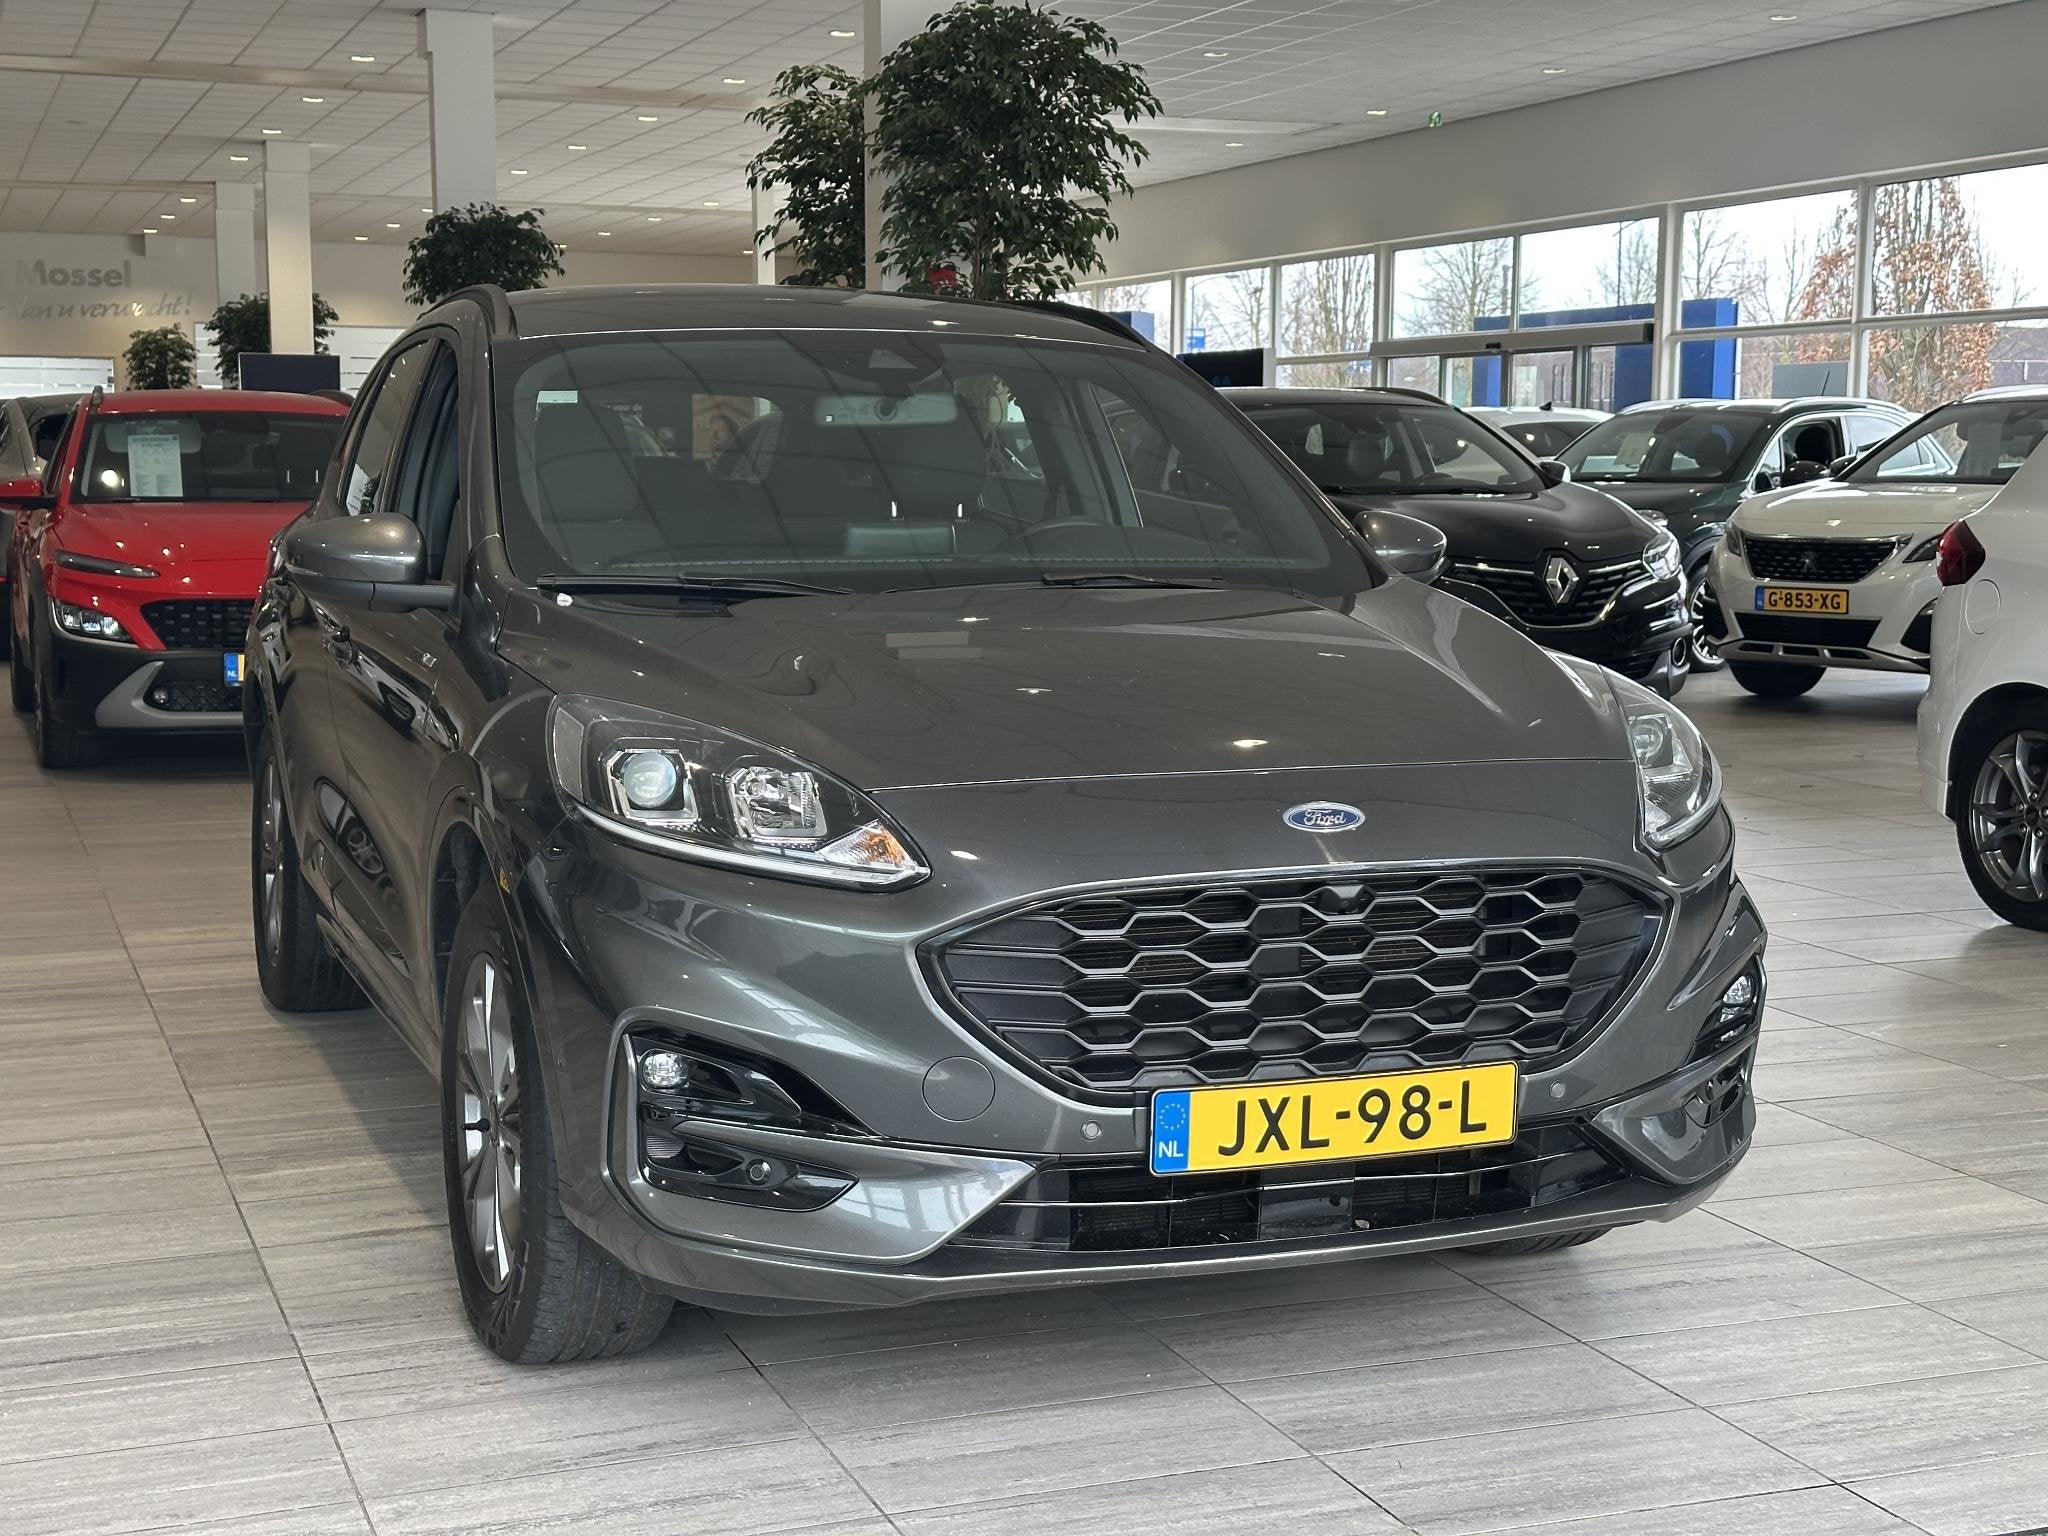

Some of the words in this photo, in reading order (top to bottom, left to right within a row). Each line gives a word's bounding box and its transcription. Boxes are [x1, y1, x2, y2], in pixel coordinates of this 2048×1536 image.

[16, 259, 131, 287] Mossel
[1767, 591, 1841, 610] G-853-XG
[1303, 808, 1346, 826] Ford
[1158, 1140, 1184, 1158] NL
[1218, 1079, 1487, 1157] JXL-98-L
